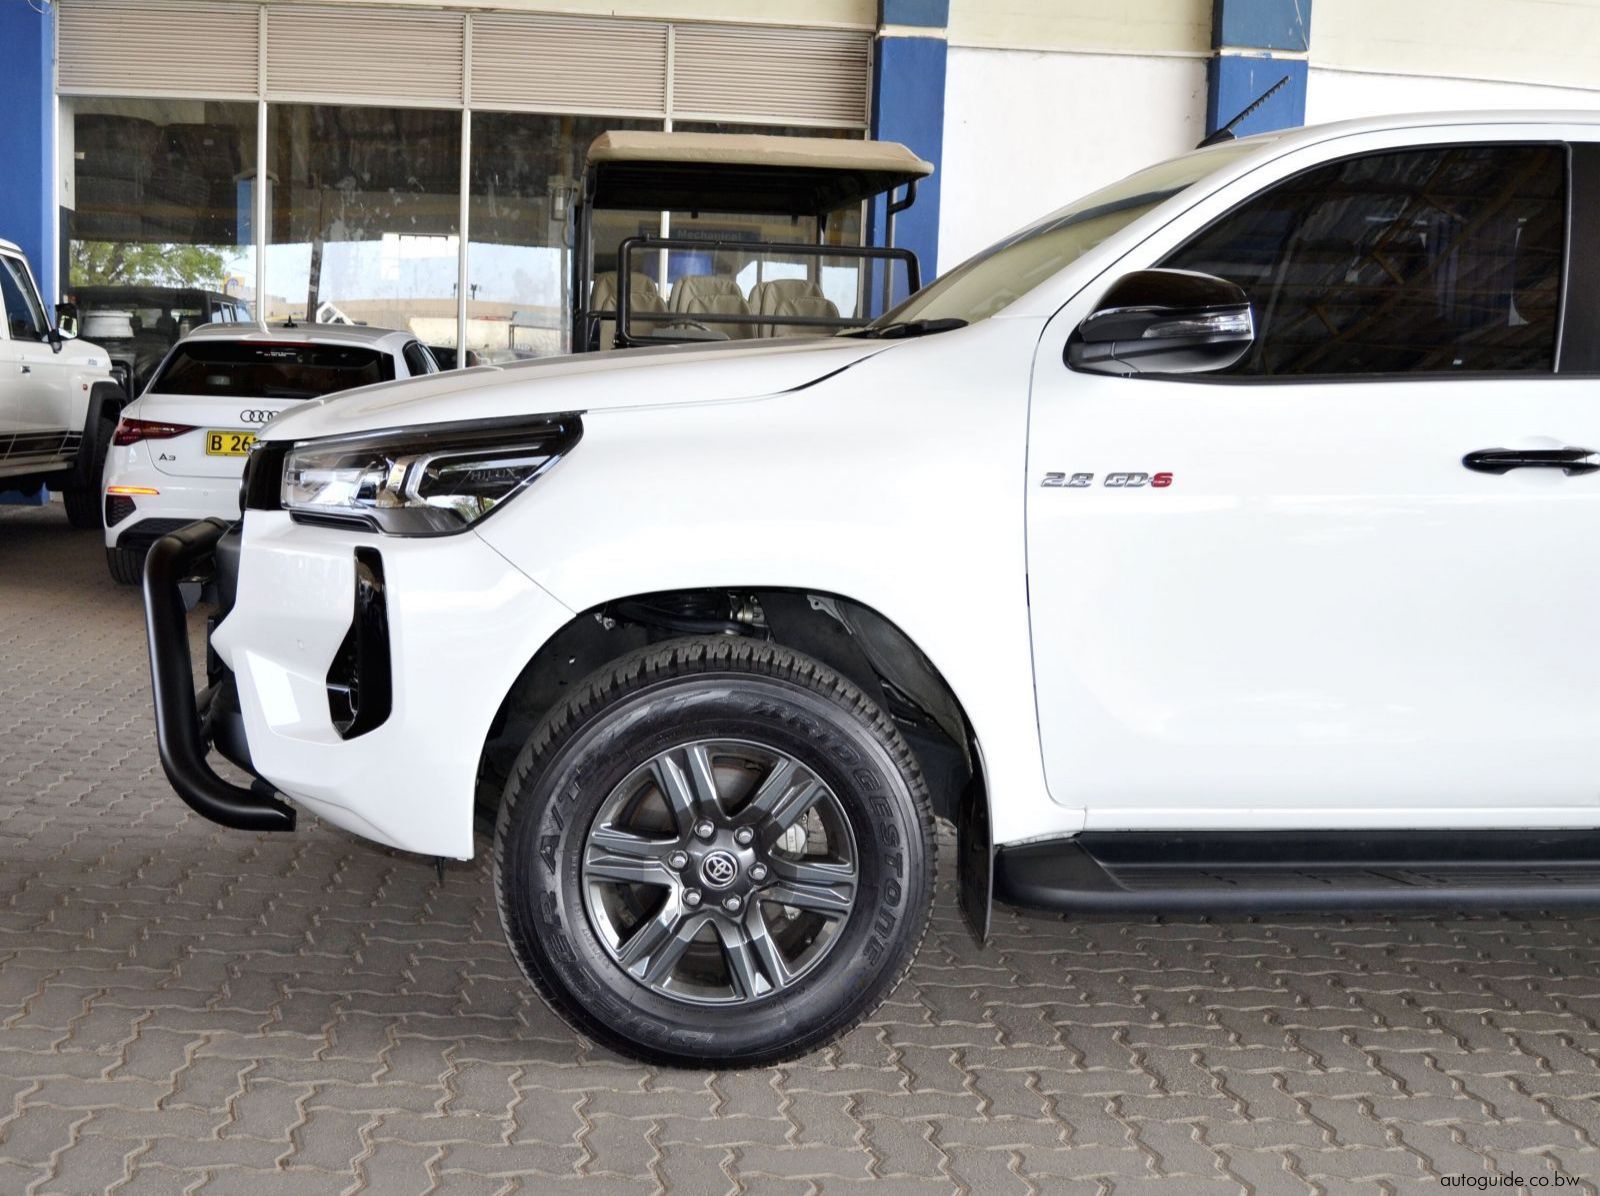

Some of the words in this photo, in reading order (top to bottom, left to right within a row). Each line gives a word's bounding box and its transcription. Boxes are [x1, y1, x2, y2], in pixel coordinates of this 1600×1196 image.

[677, 230, 742, 242] Mechanical
[211, 435, 223, 451] B
[159, 452, 177, 462] A3
[1041, 472, 1095, 488] 2.8
[1104, 472, 1174, 488] GD-6
[750, 701, 904, 966] BRIDGESTONE
